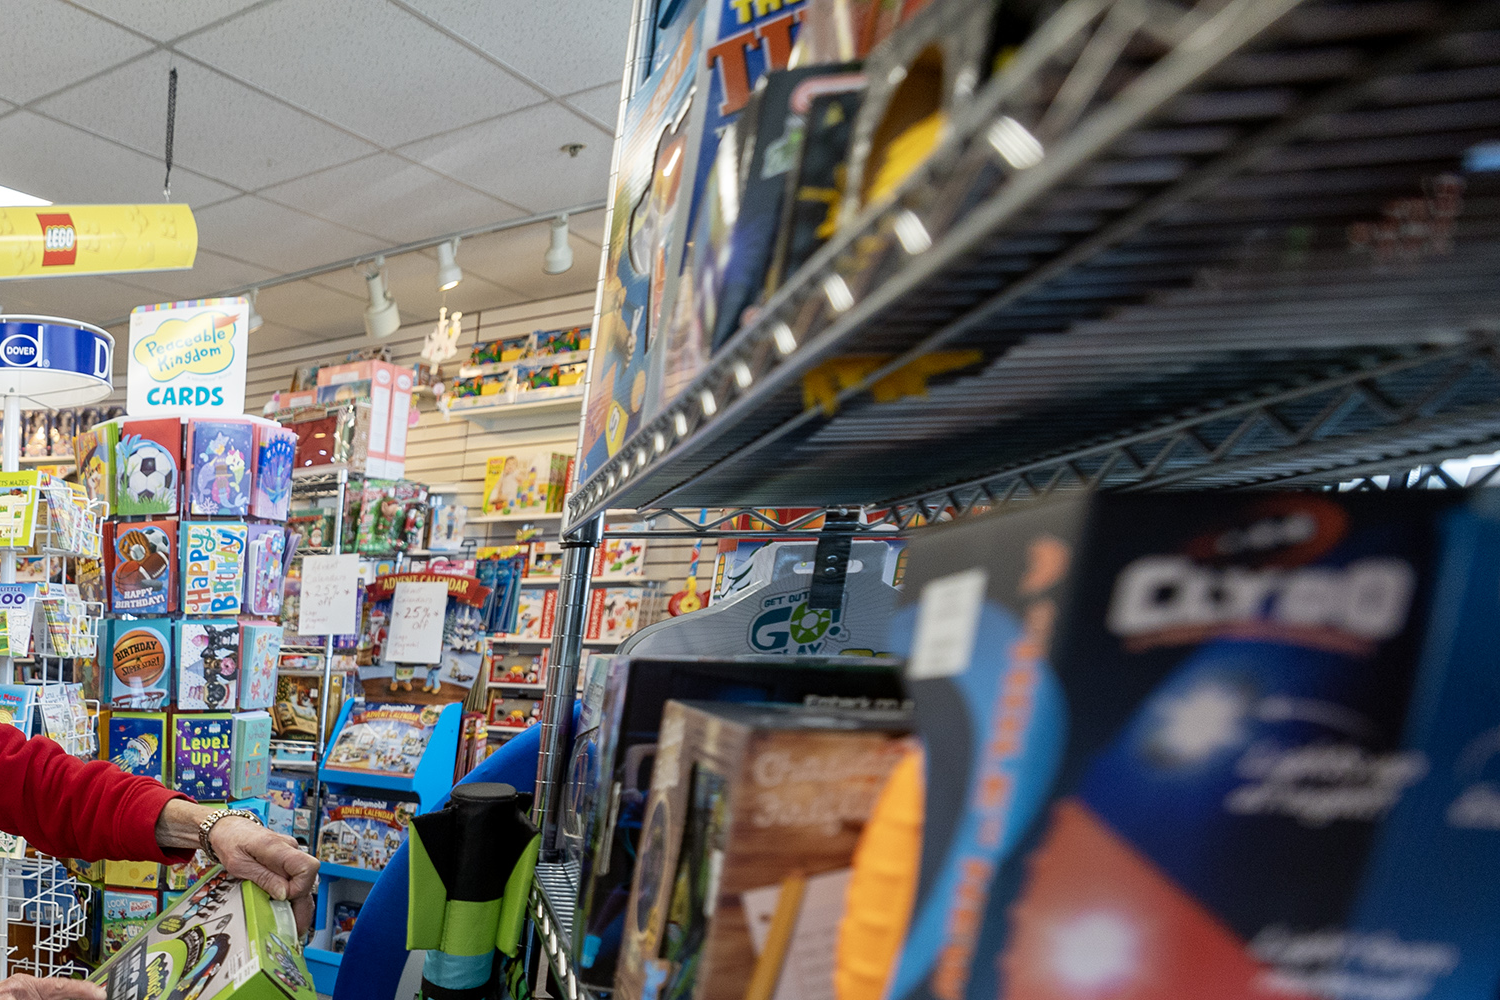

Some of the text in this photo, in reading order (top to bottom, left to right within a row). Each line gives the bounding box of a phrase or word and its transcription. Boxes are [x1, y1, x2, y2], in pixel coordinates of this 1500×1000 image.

[46, 226, 75, 251] LEGO
[145, 315, 226, 357] Peaceable
[6, 344, 35, 355] DOVER
[157, 347, 221, 372] Kingdom
[147, 386, 224, 406] CARDS
[124, 587, 155, 600] HAPPY
[764, 593, 809, 607] GET OUT
[114, 595, 165, 609] BIRTHDAY!
[404, 606, 431, 619] 25%
[115, 641, 157, 662] BIRTHDAY
[122, 663, 143, 676] SUPER
[3, 693, 22, 702] Mazes
[379, 703, 415, 711] playmobil
[389, 712, 419, 722] CALENDAR
[182, 734, 230, 751] Level
[191, 751, 219, 768] Up!
[352, 798, 387, 809] playmobil
[341, 807, 394, 821] ADVENT CALENDAR
[107, 899, 128, 908] LOOK!
